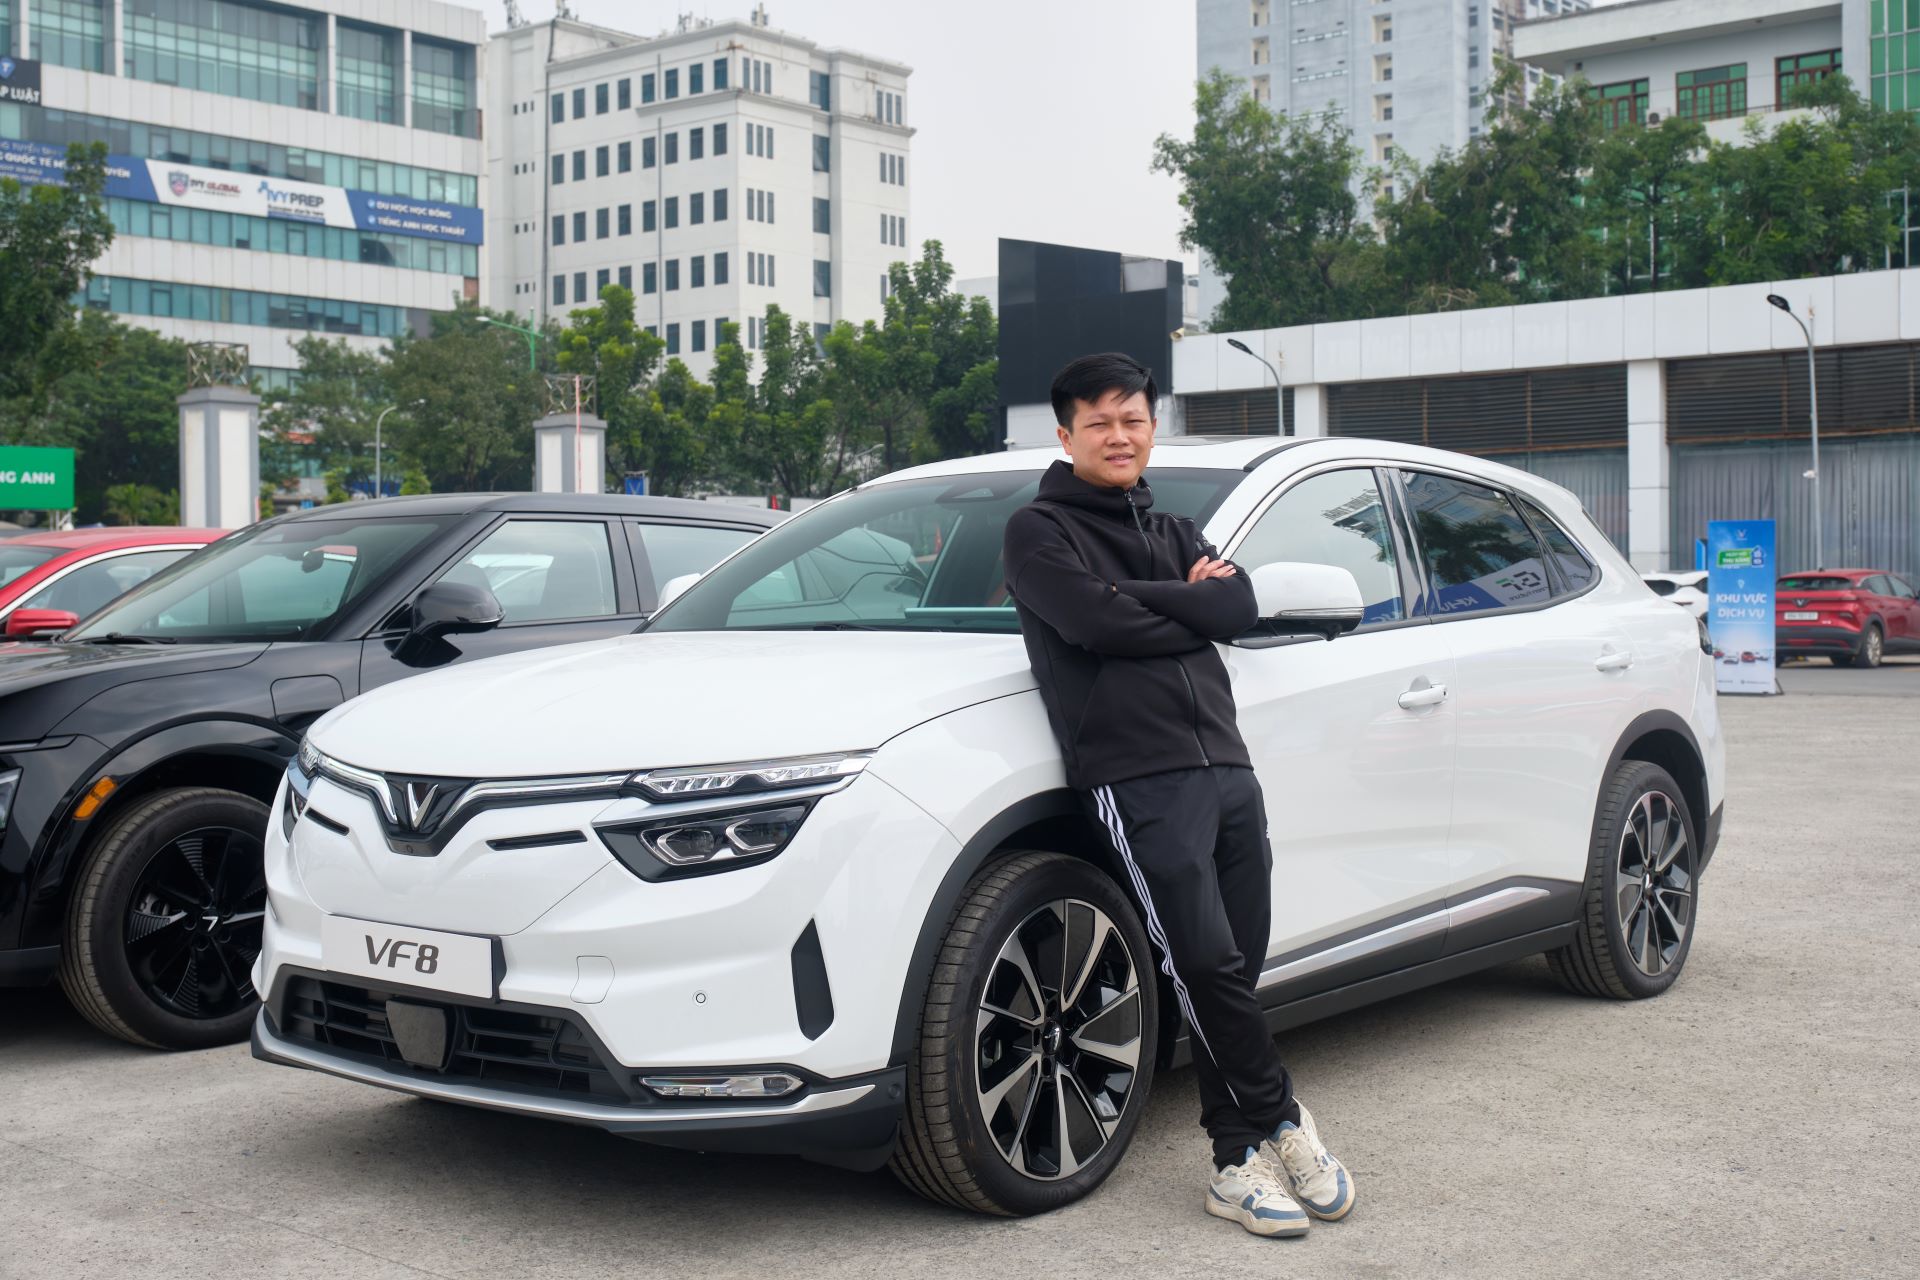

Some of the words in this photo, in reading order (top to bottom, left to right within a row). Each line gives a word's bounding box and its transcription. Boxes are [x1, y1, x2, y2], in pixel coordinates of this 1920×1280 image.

[11, 87, 40, 103] LUẬT
[403, 221, 420, 230] ANH
[421, 223, 439, 232] HỌC
[20, 471, 56, 485] ANH
[1716, 593, 1740, 604] KHU
[1743, 592, 1767, 605] VỰC
[1718, 608, 1745, 619] DỊCH
[1748, 608, 1765, 619] VỤ
[365, 934, 440, 975] VF8
